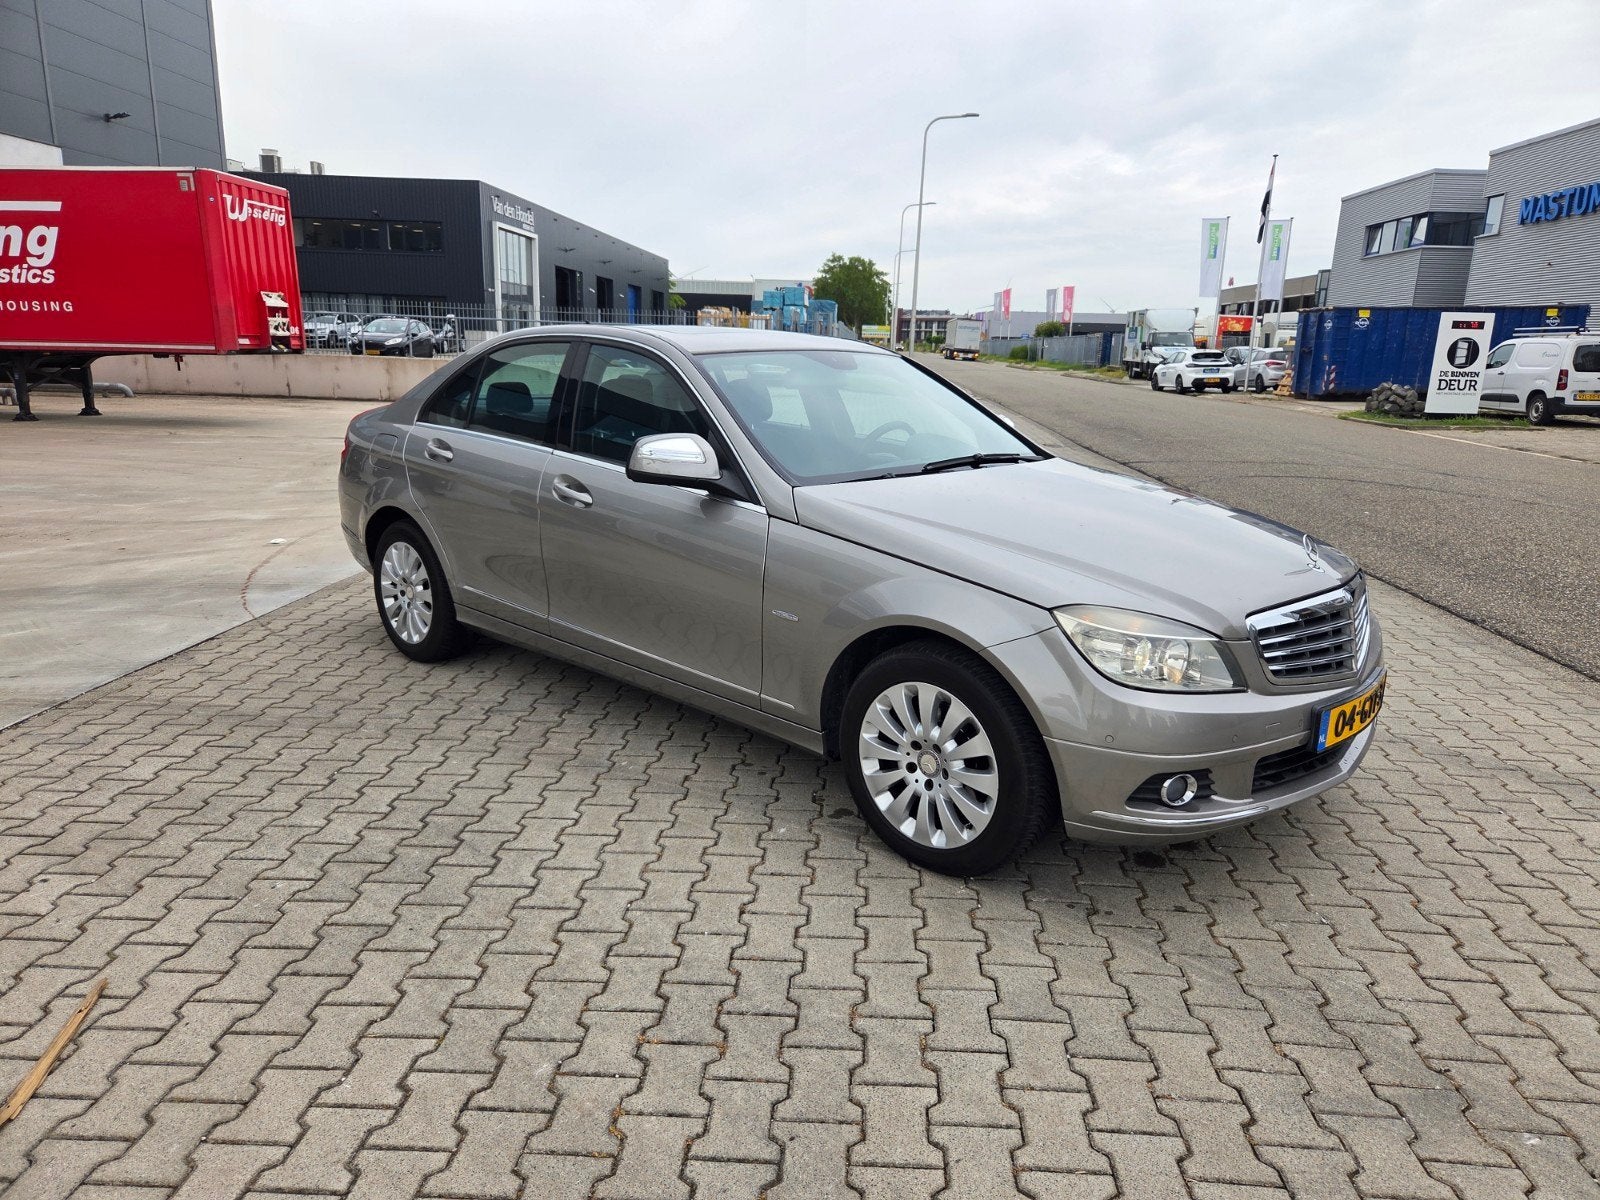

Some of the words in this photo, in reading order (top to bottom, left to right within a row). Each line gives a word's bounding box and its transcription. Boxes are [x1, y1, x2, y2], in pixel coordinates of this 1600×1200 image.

[490, 195, 504, 215] Van
[504, 201, 515, 219] den
[0, 300, 74, 312] OUSING
[1439, 370, 1450, 378] DE
[1436, 379, 1478, 391] DEUR
